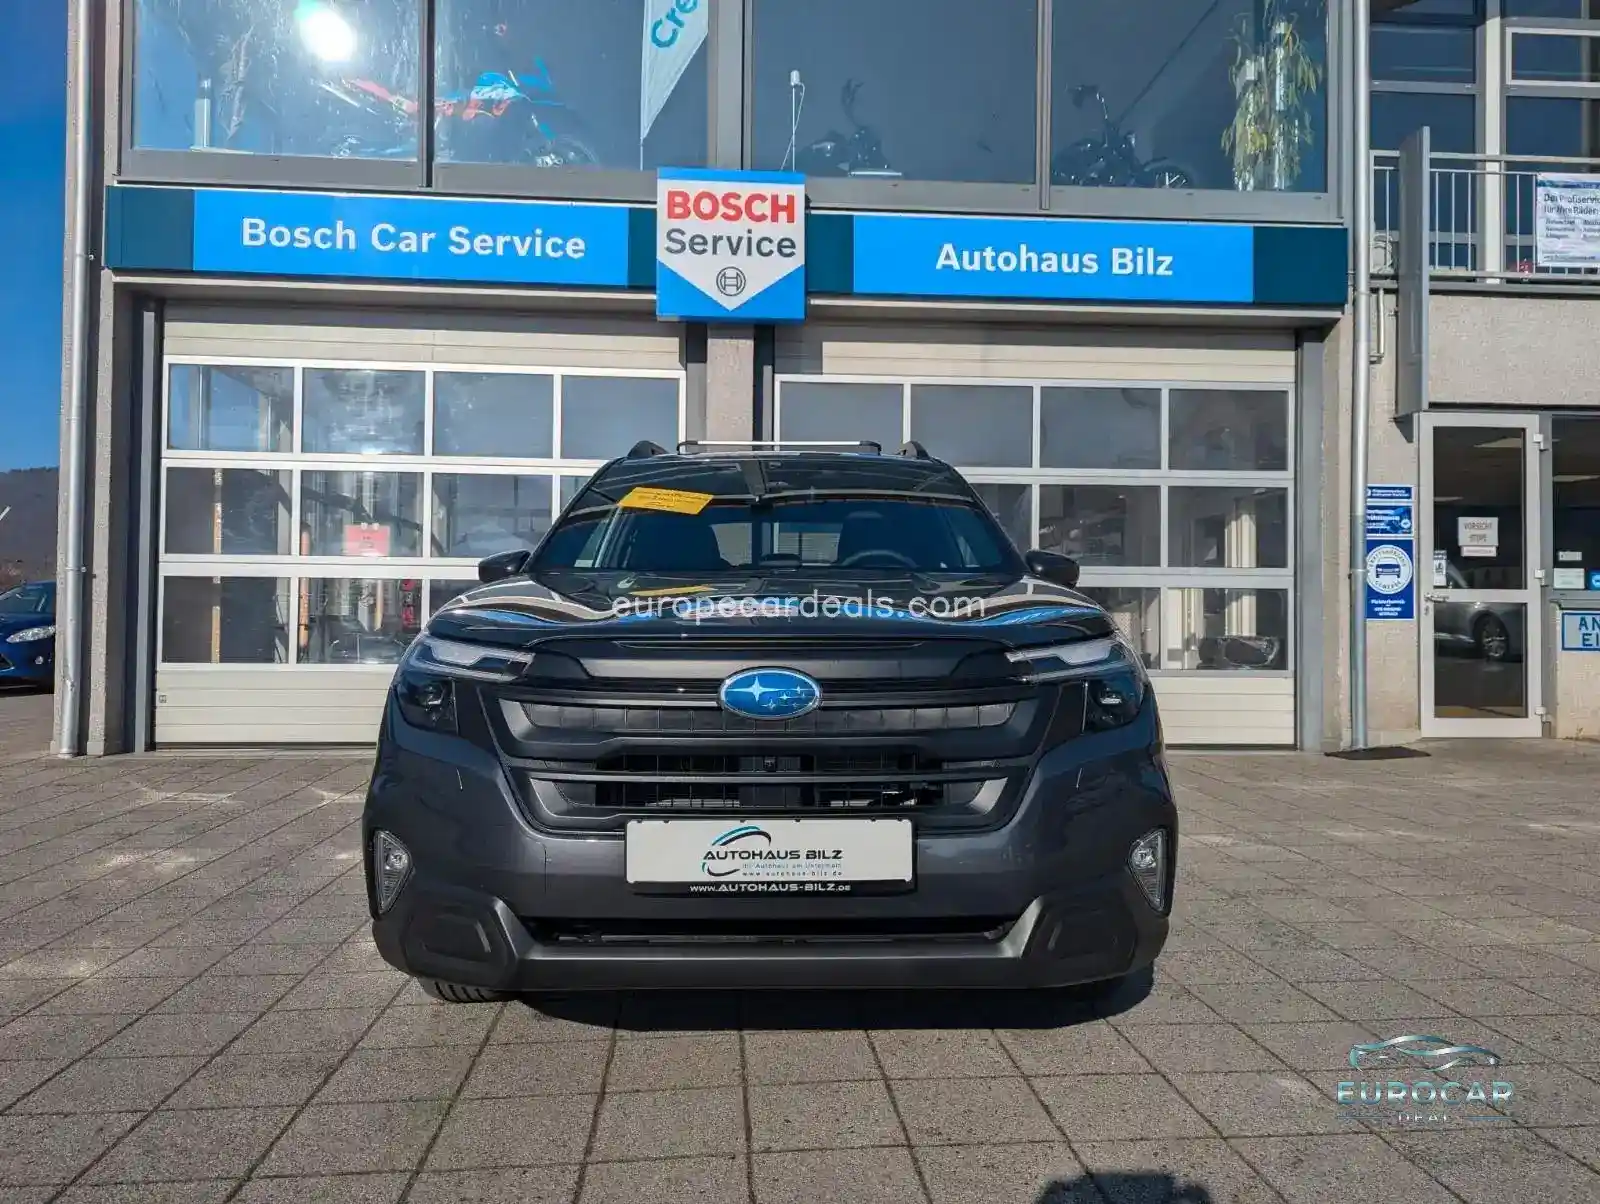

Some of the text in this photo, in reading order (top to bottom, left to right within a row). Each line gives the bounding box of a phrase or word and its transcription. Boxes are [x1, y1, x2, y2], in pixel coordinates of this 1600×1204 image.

[667, 190, 795, 224] BOSCH
[242, 217, 586, 259] Bosch Car Service
[664, 228, 796, 258] Service
[935, 243, 1174, 276] Autohaus Bilz
[1578, 616, 1600, 631] AN
[703, 850, 843, 860] AUTOHAUS BILZ
